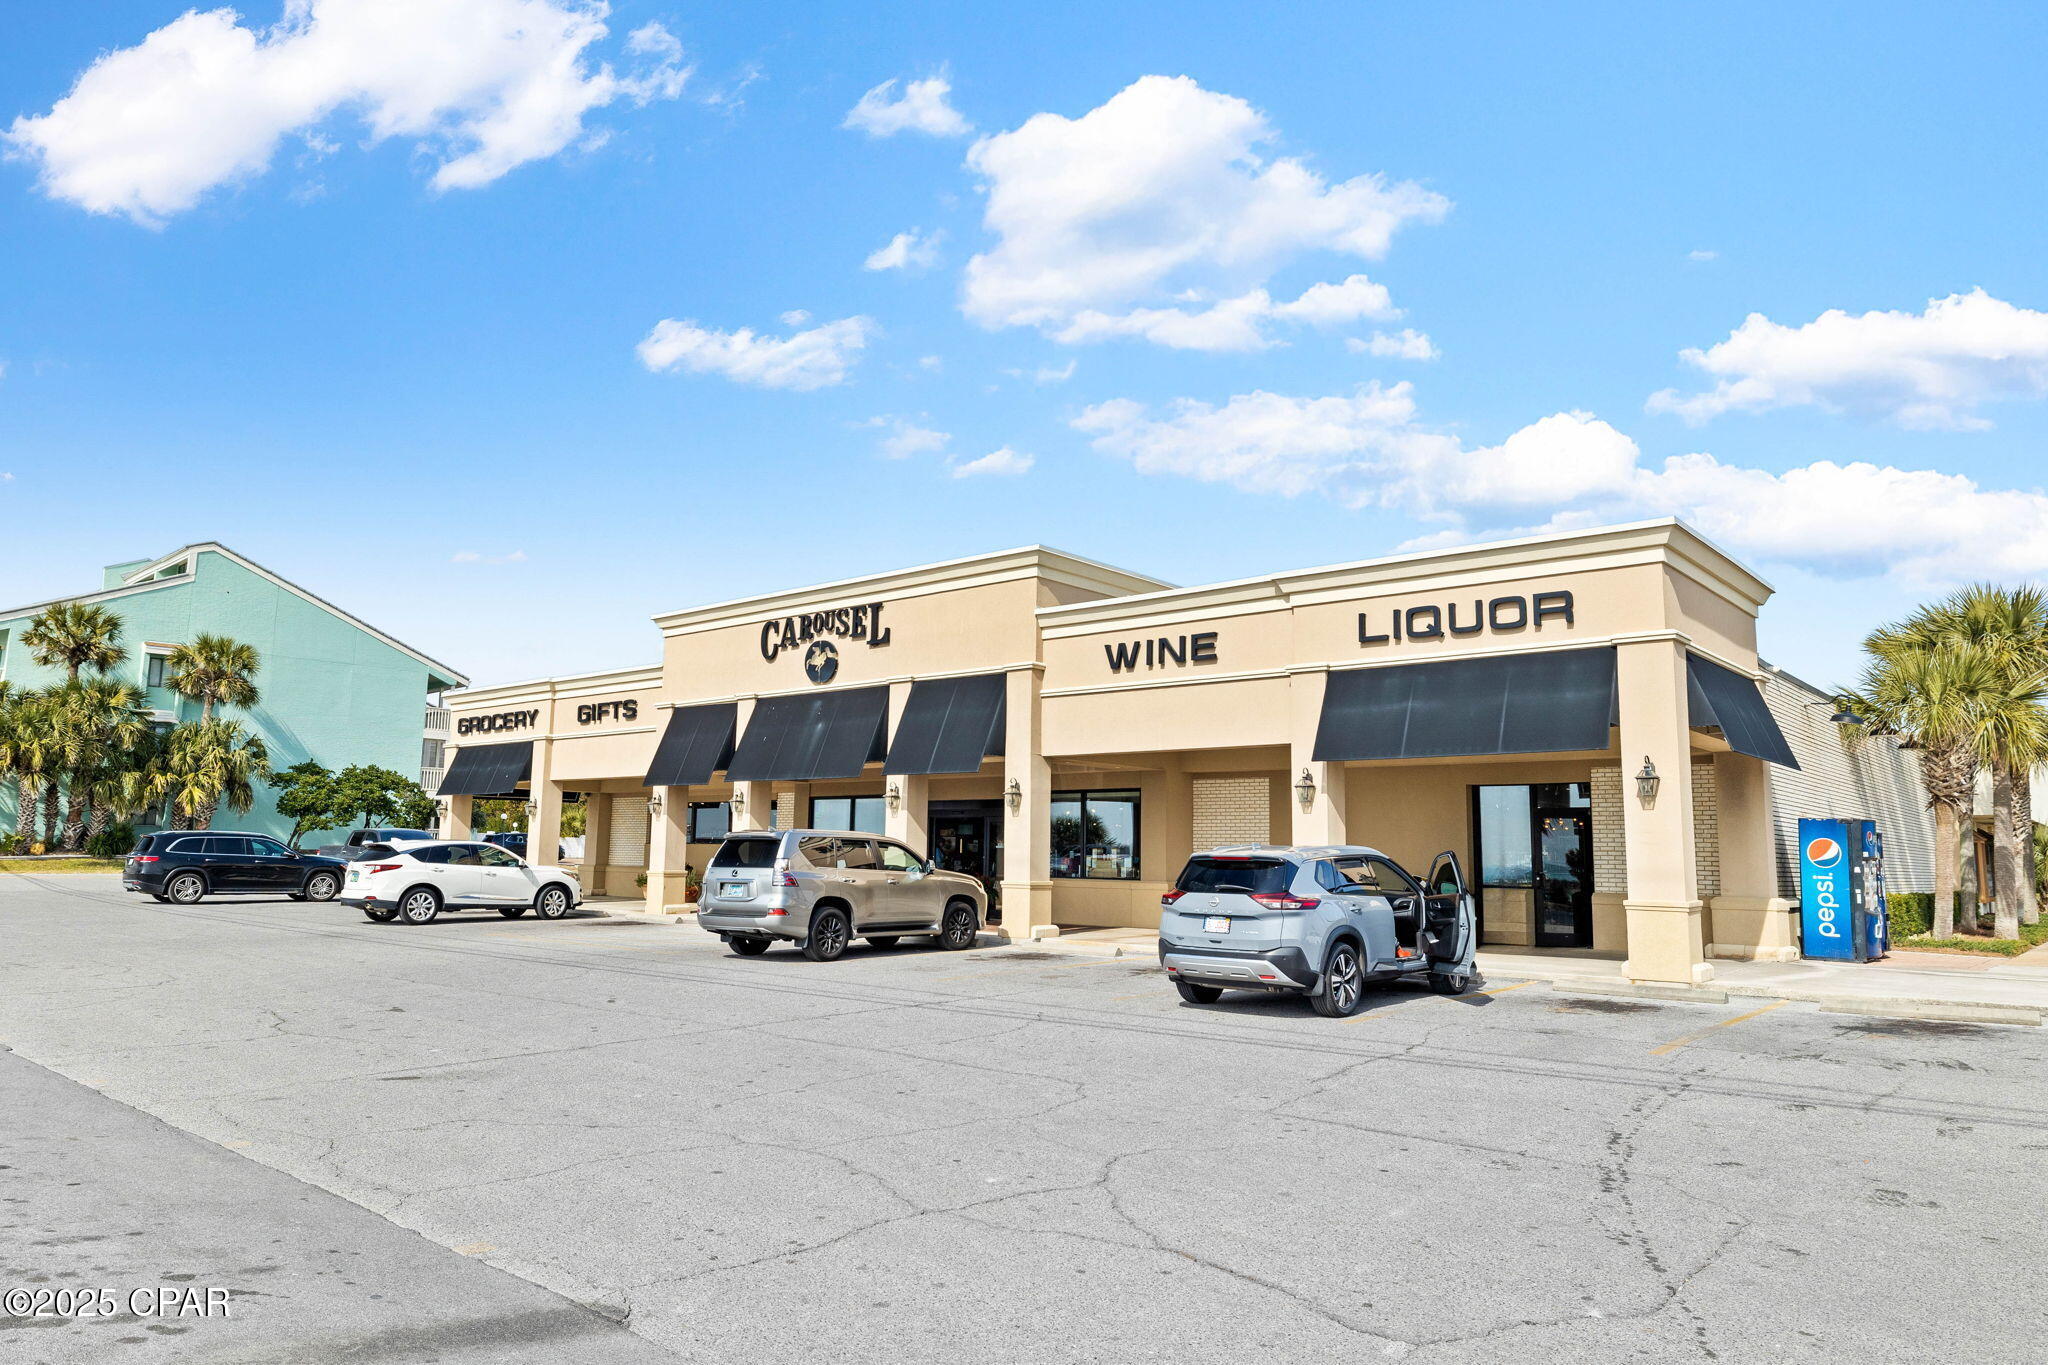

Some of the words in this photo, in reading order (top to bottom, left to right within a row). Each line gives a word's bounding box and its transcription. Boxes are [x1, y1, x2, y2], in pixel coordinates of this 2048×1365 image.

[761, 602, 891, 660] CAROUSEL
[1358, 590, 1574, 642] LIQUOR
[1104, 631, 1218, 670] WINE
[457, 709, 539, 734] GROCERY
[577, 699, 638, 724] GIFTS
[1812, 872, 1841, 938] pepsi
